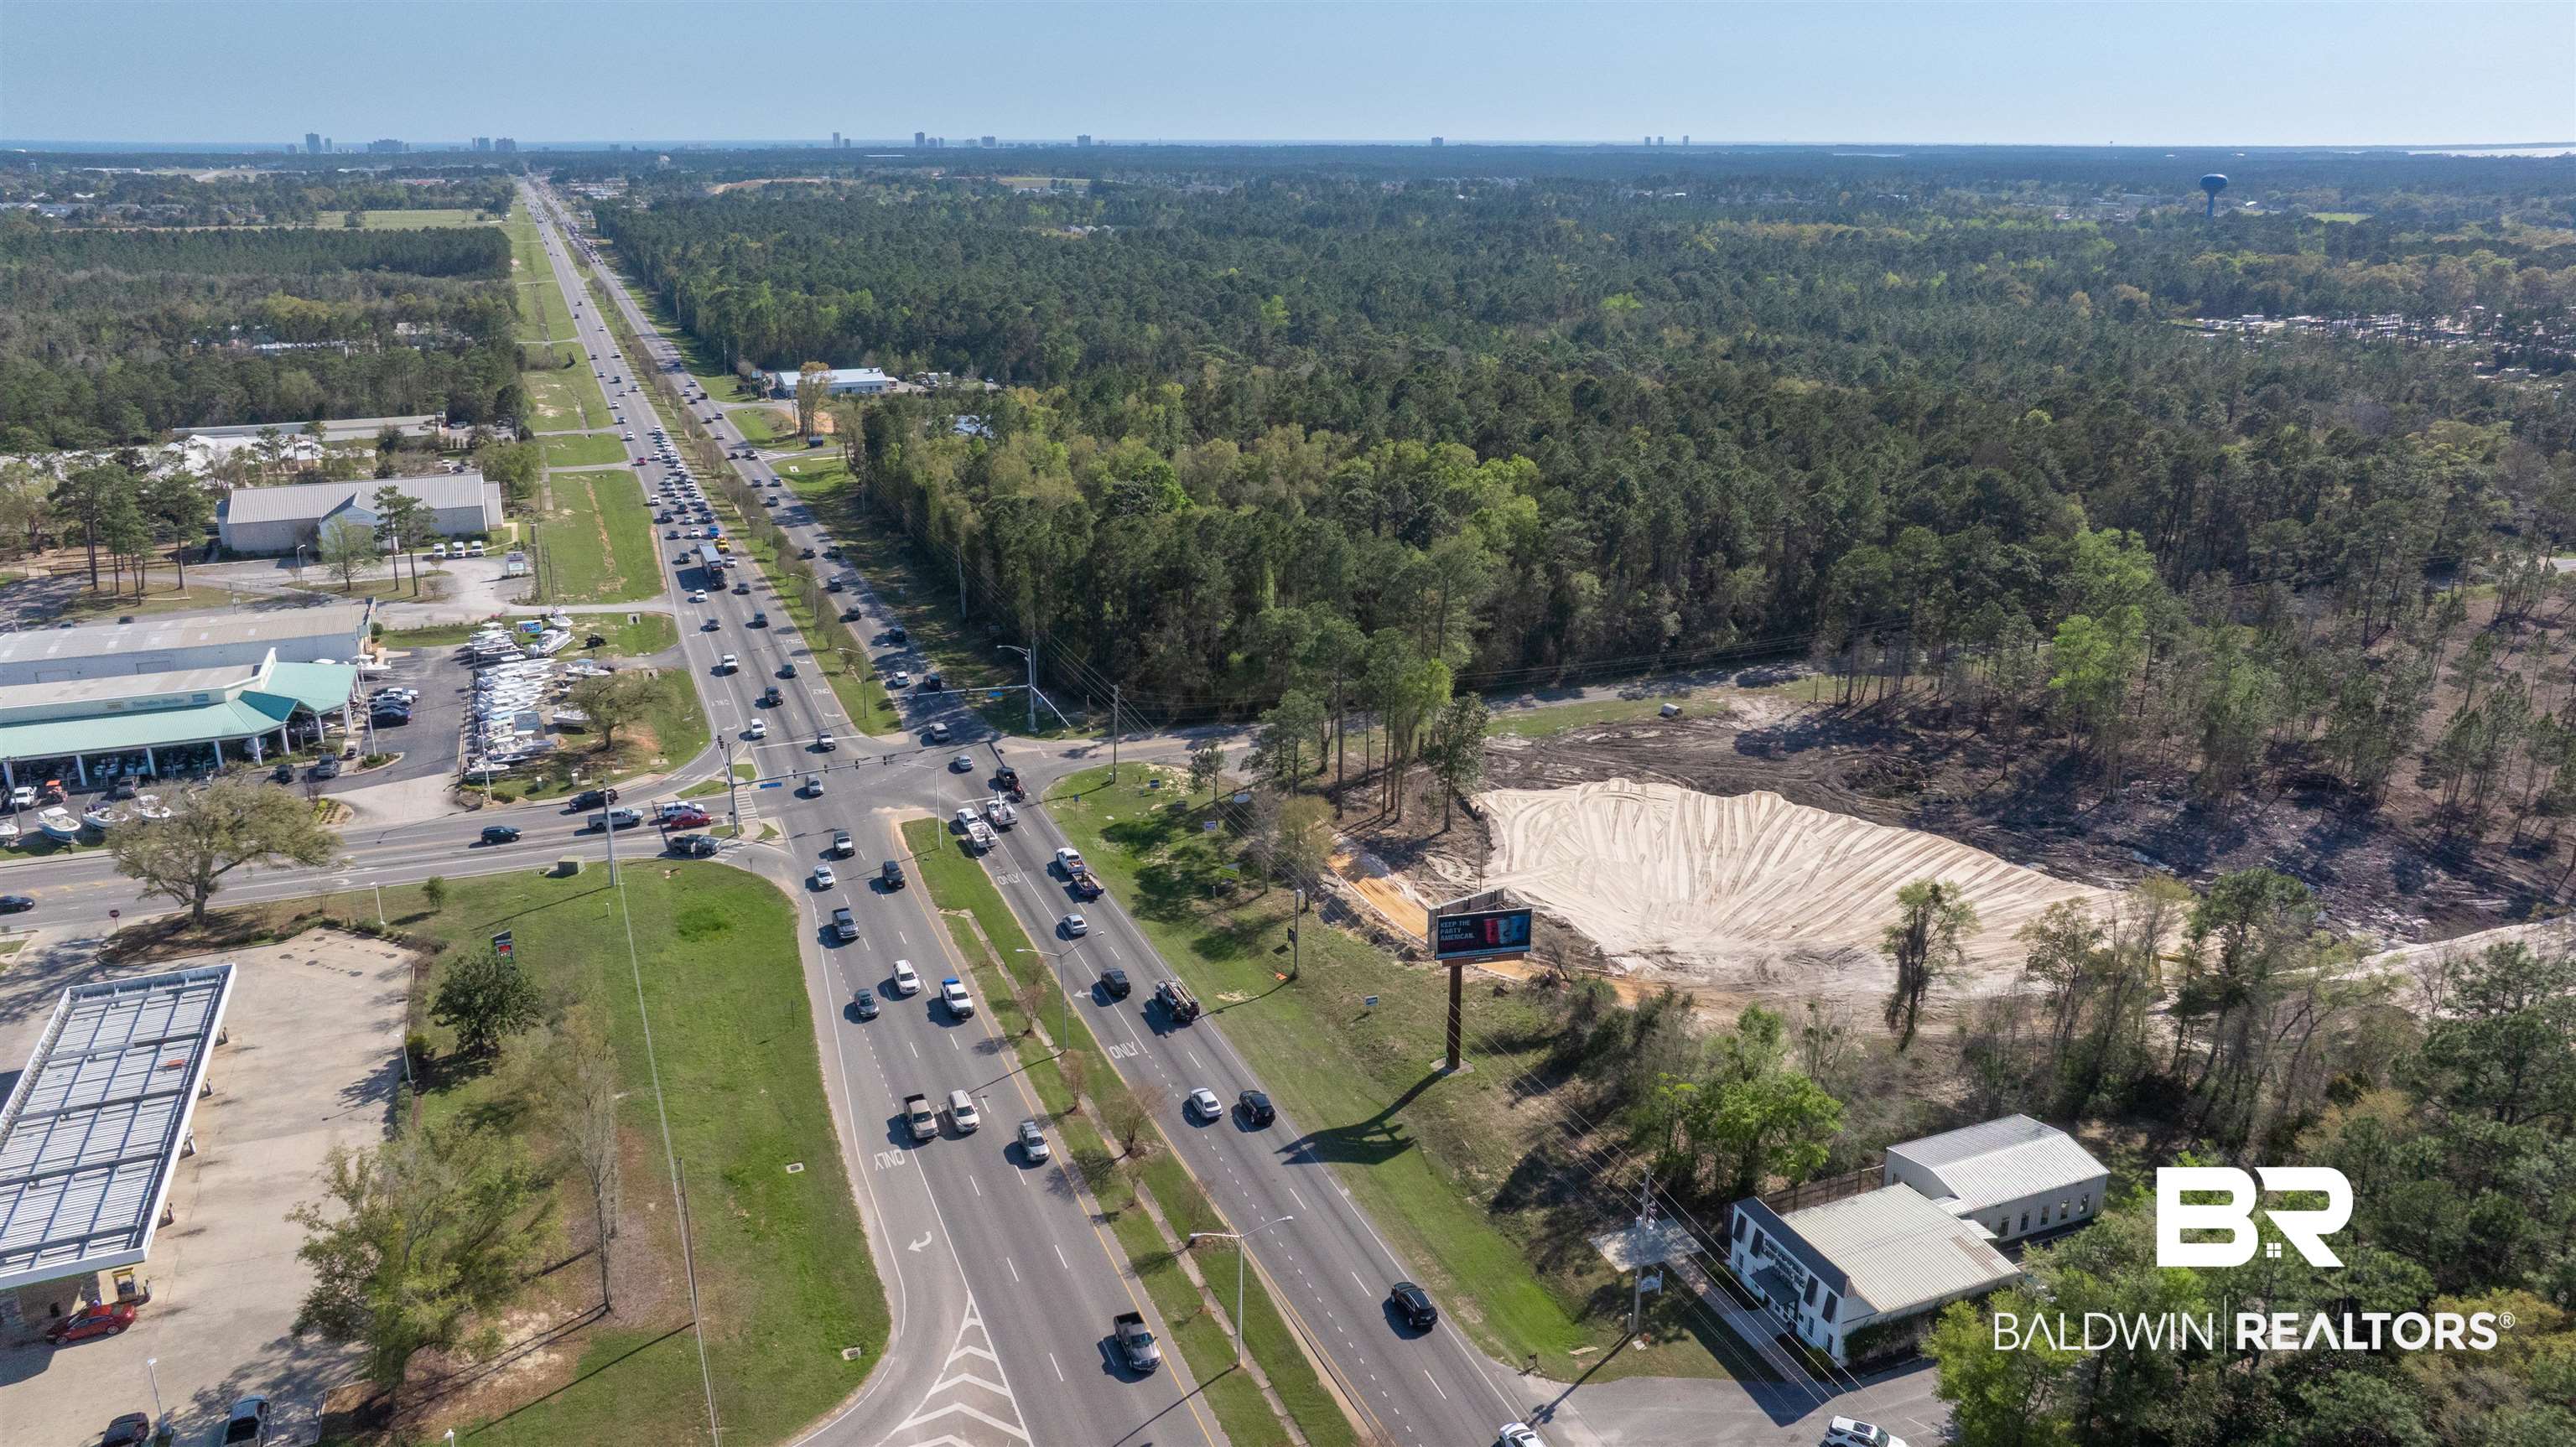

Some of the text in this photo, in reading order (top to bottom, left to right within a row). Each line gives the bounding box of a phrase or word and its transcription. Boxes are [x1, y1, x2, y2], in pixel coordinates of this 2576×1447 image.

[996, 873, 1021, 886] ONLY
[1440, 932, 1476, 941] AMERICAN.
[1109, 1041, 1140, 1060] ONLY
[874, 1149, 906, 1171] ONLY
